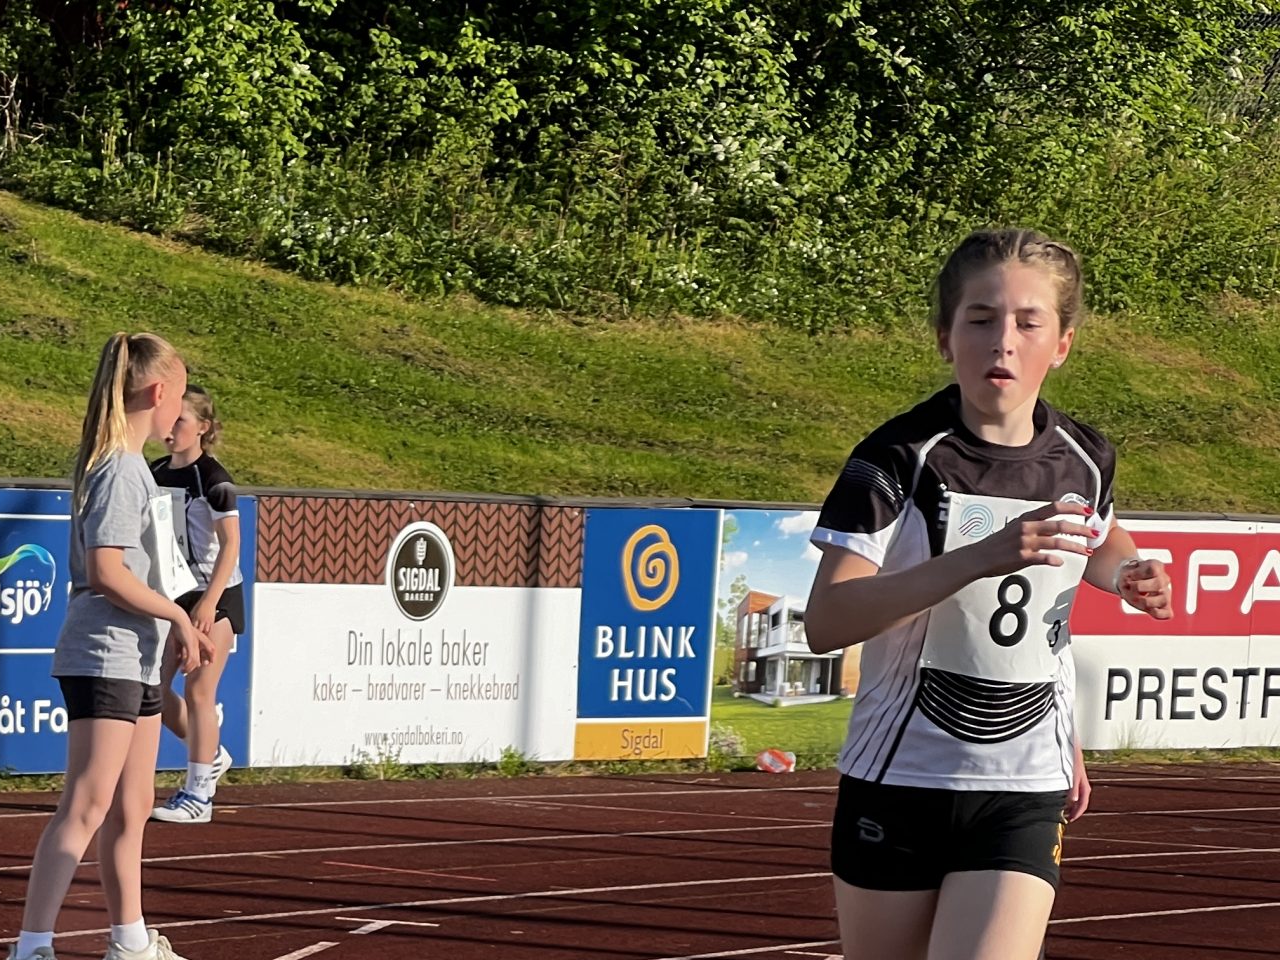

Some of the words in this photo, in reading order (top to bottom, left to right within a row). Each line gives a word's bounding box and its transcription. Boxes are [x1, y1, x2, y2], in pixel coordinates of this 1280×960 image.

[398, 567, 441, 591] SIGDAL
[989, 574, 1032, 647] 8
[1048, 619, 1061, 648] 3
[347, 630, 373, 666] Din
[381, 628, 433, 666] lokale
[441, 628, 489, 666] baker
[595, 625, 696, 658] BLINK
[313, 674, 348, 701] kaker
[367, 674, 426, 700] brødvarer
[446, 673, 520, 700] knekkebrød
[610, 668, 677, 701] HUS
[33, 699, 69, 733] Fa
[621, 728, 663, 755] Sigdal
